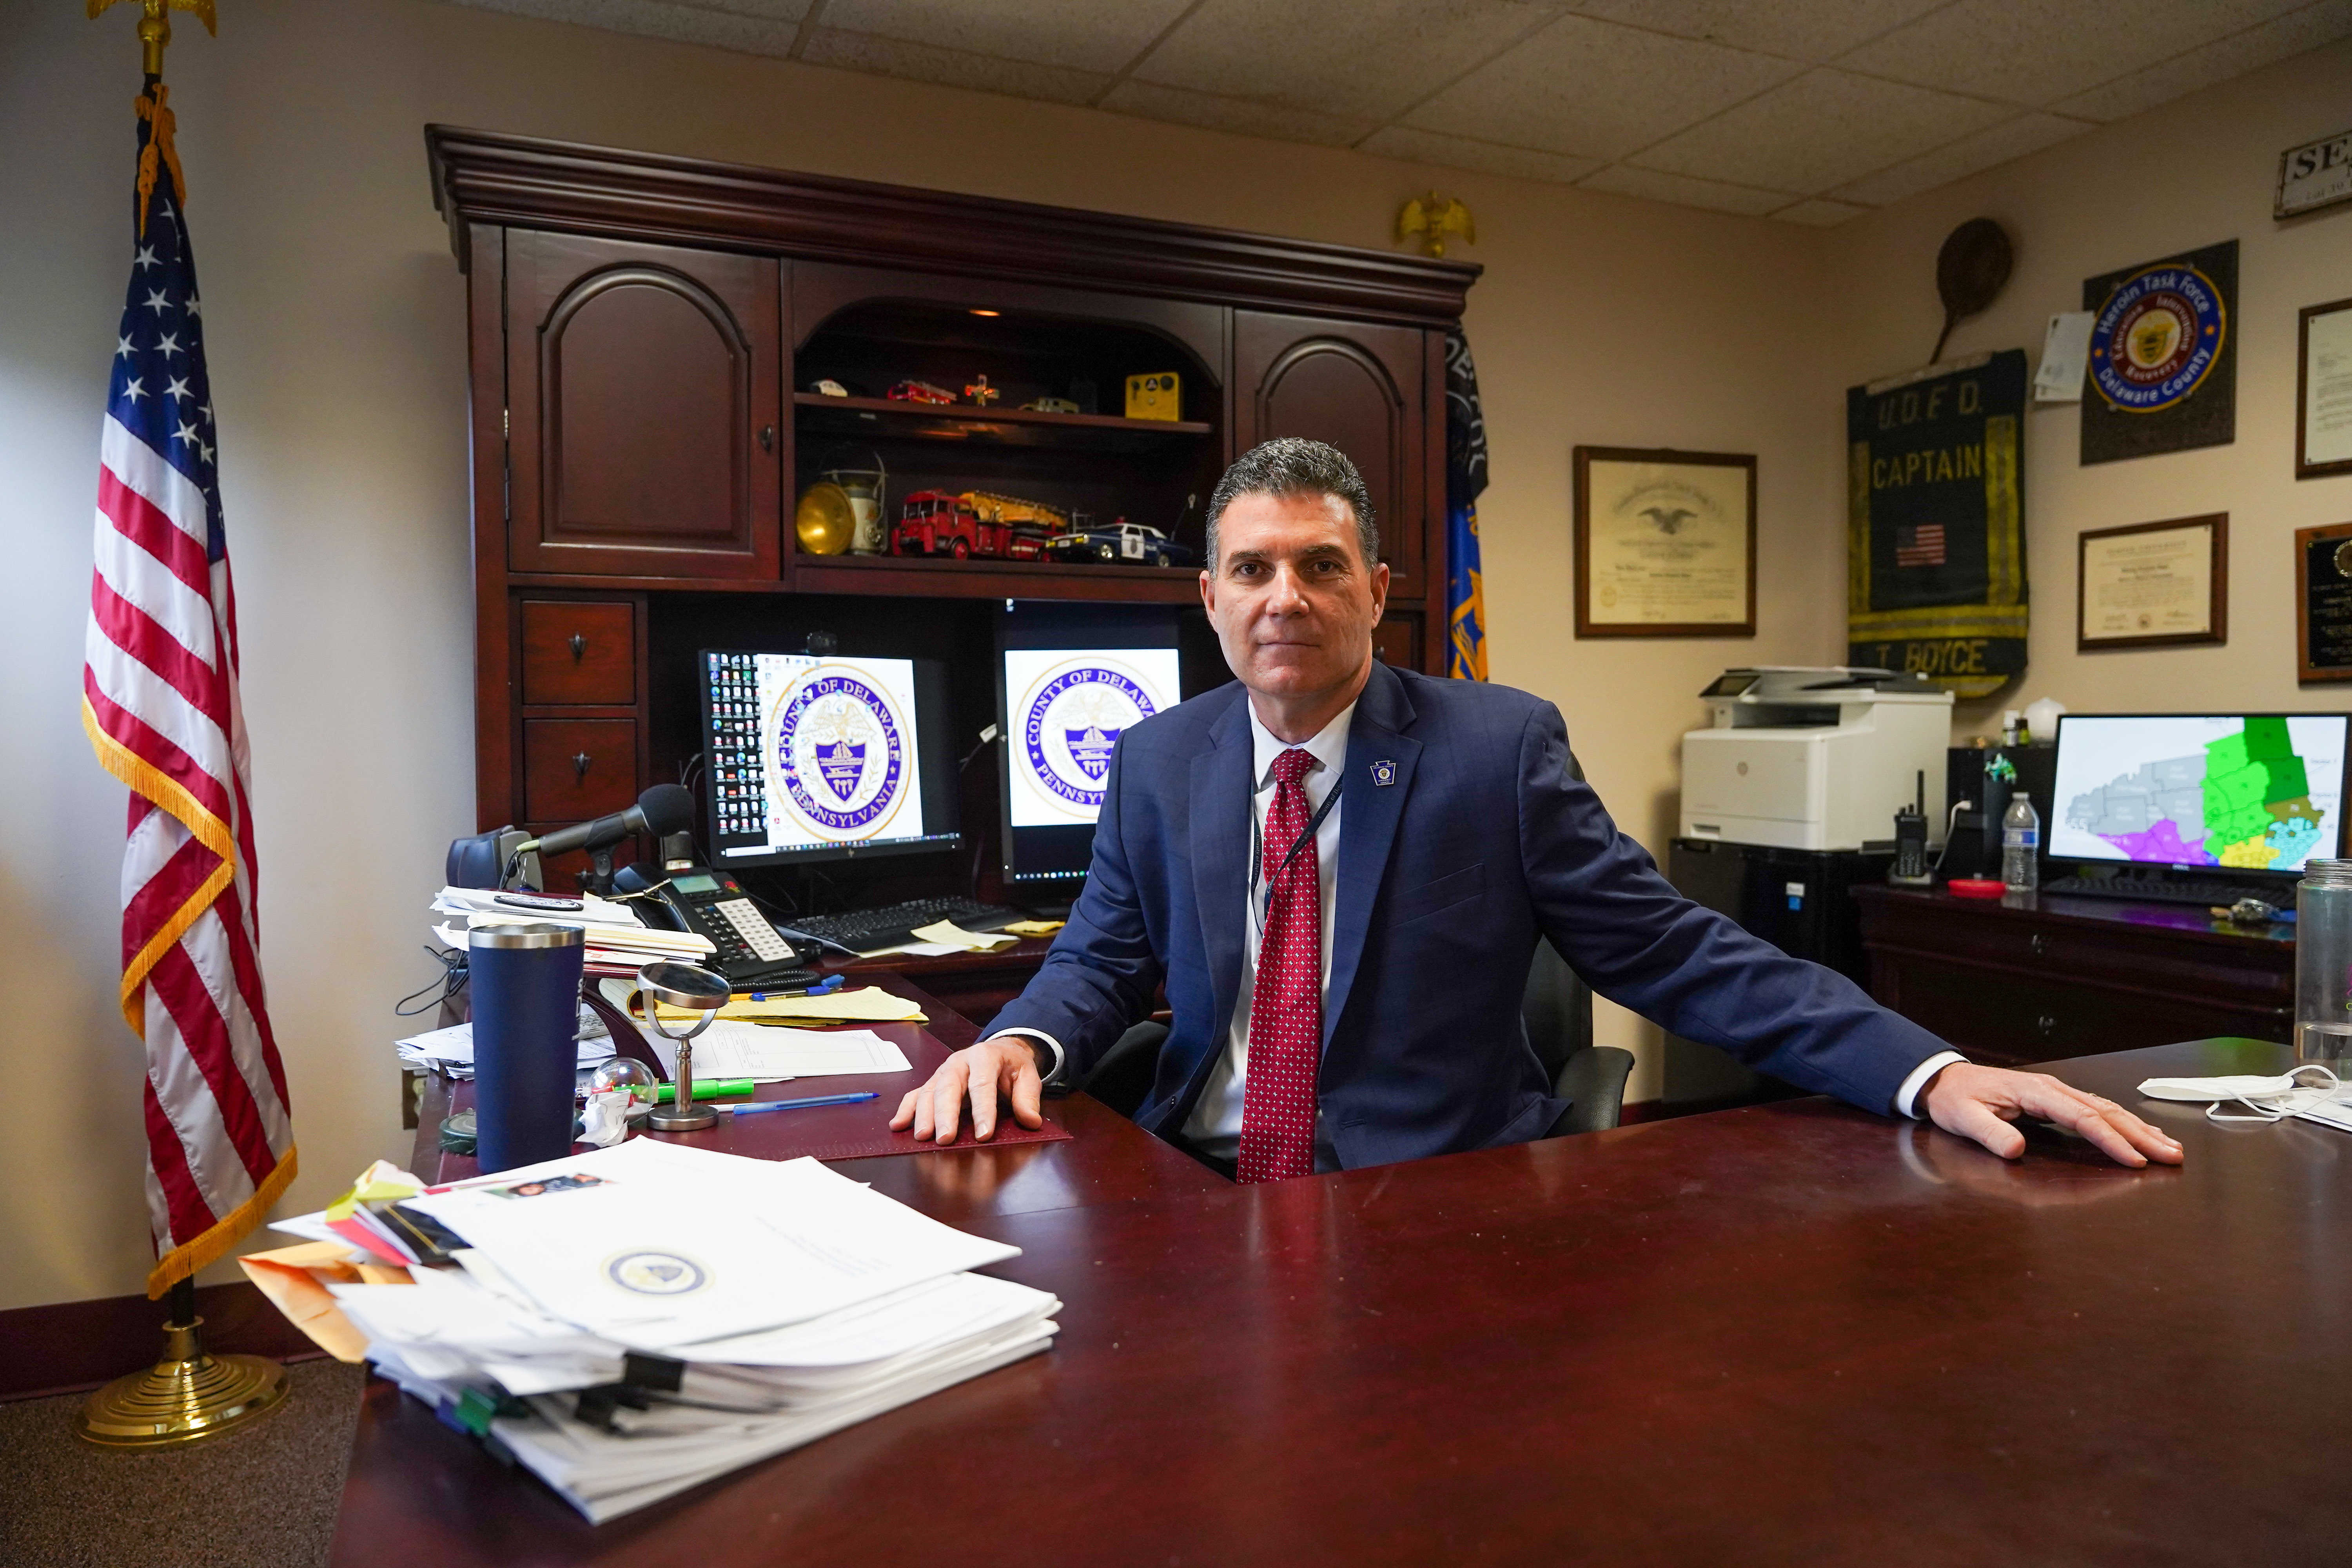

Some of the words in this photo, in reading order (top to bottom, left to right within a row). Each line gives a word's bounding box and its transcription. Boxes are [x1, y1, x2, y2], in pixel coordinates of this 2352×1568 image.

[2098, 287, 2140, 333] Heroin
[2142, 271, 2176, 292] Task
[2178, 275, 2210, 313] Force
[2100, 367, 2158, 403] Delaware
[2161, 347, 2210, 396] County
[1873, 443, 1981, 489] CAPTAIN
[1904, 639, 1989, 675] BOYCE
[817, 679, 838, 695] OF
[843, 680, 901, 761] DELAWARE
[1028, 678, 1065, 746] COUNTY
[1069, 670, 1092, 685] OF
[791, 779, 897, 827] PENNSYLVANIA
